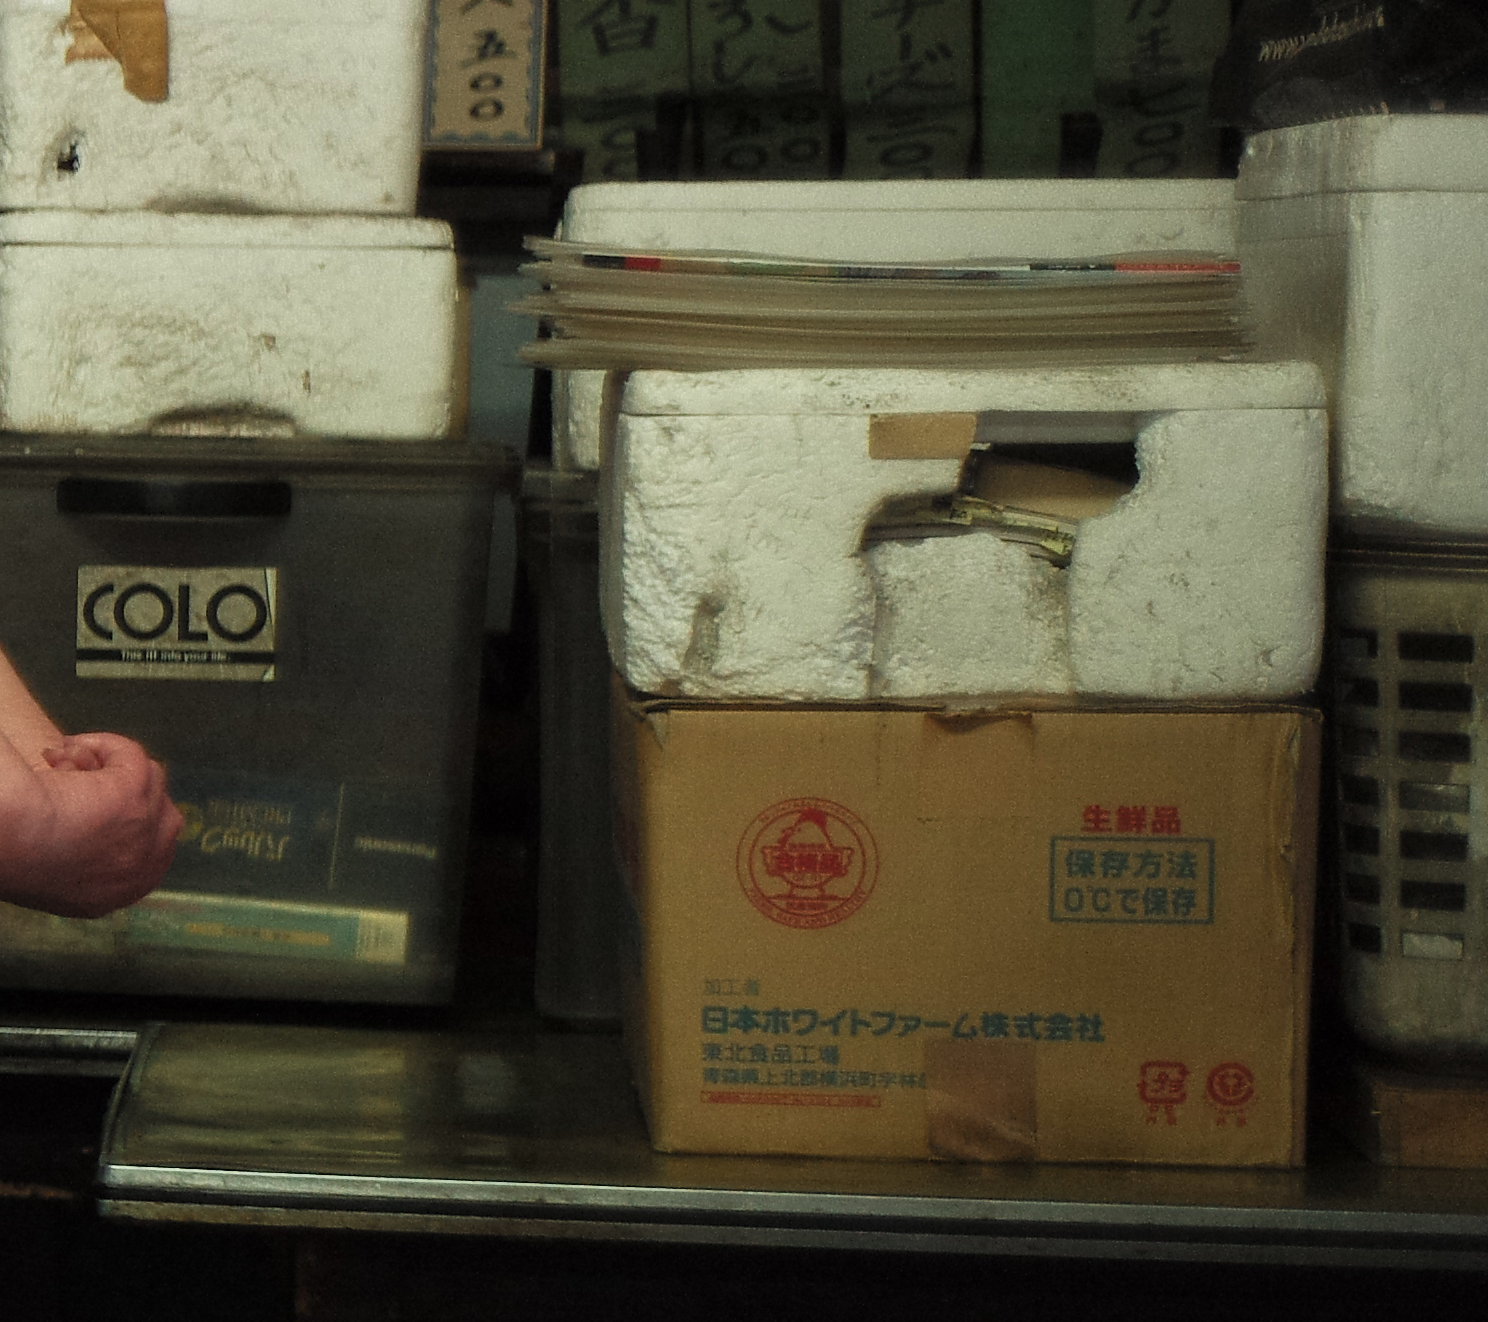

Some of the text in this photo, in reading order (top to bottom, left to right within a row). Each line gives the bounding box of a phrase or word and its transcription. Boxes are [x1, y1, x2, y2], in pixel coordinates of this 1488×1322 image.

[1081, 804, 1181, 835] 生鮮品
[1065, 849, 1198, 880] 保存方法
[700, 1004, 1107, 1044] 日本ホワイトファーム株式会社
